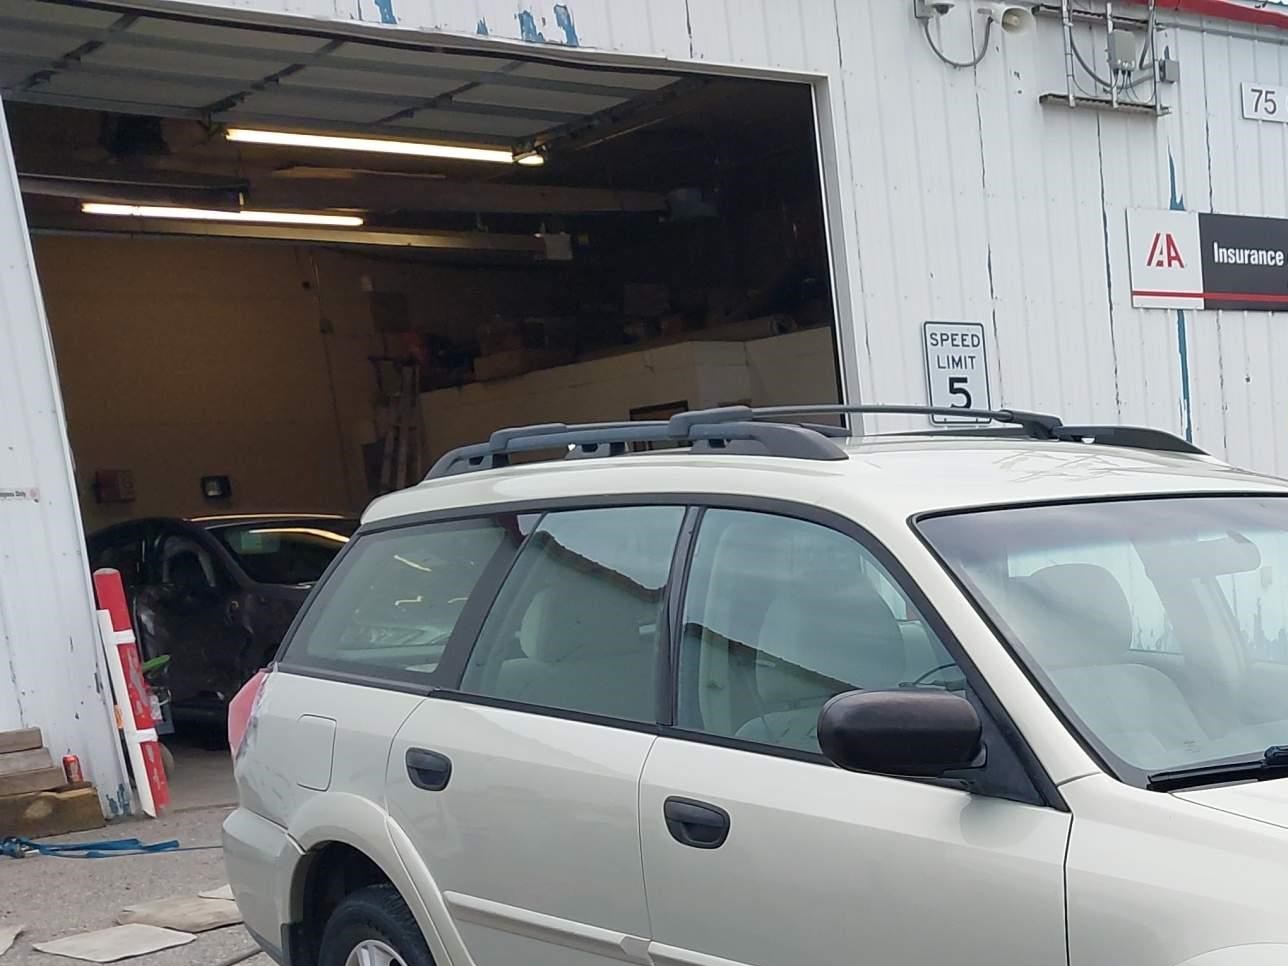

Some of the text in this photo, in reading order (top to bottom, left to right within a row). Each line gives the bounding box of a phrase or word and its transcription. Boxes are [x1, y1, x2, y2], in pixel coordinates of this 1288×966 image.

[1251, 88, 1277, 115] 75
[1213, 241, 1284, 267] Insurance
[930, 332, 981, 348] SPEED
[936, 354, 976, 370] LIMIT
[948, 376, 972, 409] 5
